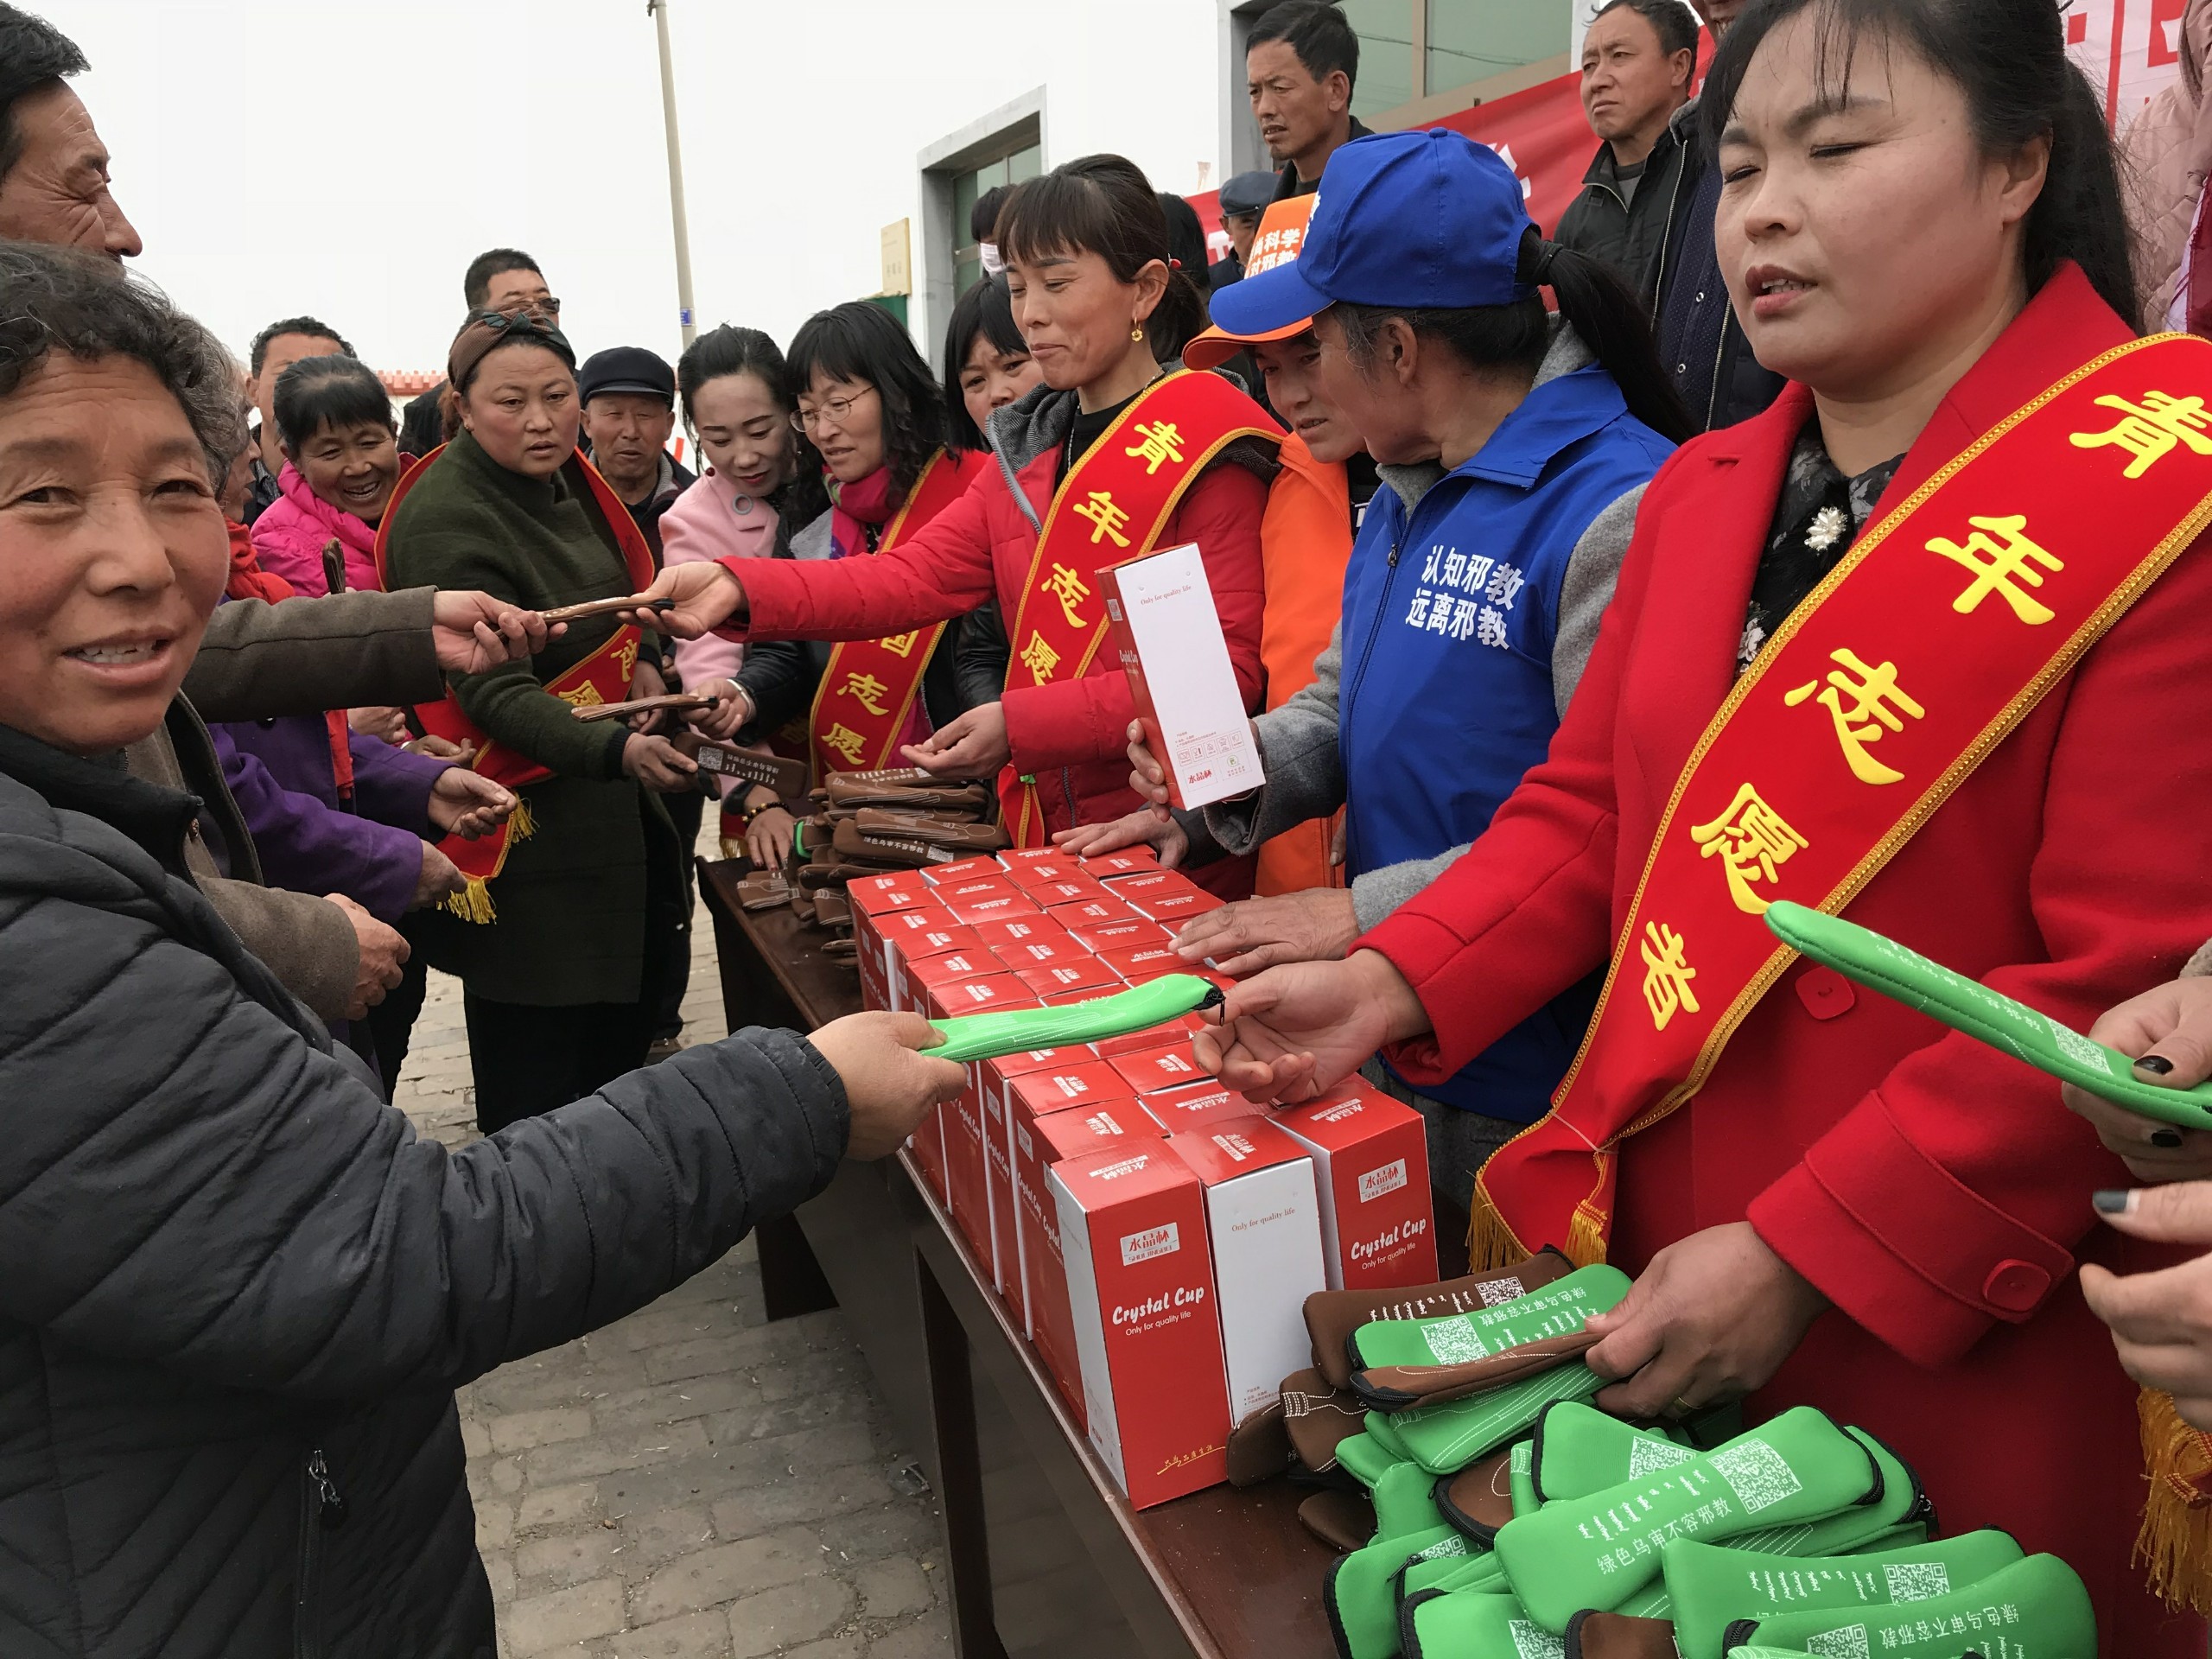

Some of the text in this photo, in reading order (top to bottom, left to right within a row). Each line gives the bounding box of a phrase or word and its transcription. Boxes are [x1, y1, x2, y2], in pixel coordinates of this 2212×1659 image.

[1252, 228, 1300, 258] 尚科学
[1164, 589, 1181, 599] quality
[1421, 544, 1524, 610] 认知邪教
[1405, 587, 1510, 650] 远离邪教
[1641, 391, 2212, 1031] 青年志愿者
[1231, 1223, 1248, 1231] Only
[1261, 1211, 1282, 1224] quality
[1351, 1218, 1427, 1260] Crystal Cup
[1362, 1260, 1376, 1270] Only
[1387, 1247, 1407, 1261] quality
[1112, 1287, 1205, 1325] Crystal Cup
[1126, 1311, 1192, 1336] Only for quality life
[1478, 1287, 1588, 1326] 绿色乌审不容邪教
[1596, 1497, 1732, 1574] 绿色乌审不容邪教
[1879, 1604, 2019, 1649] 绿色乌审不容邪教
